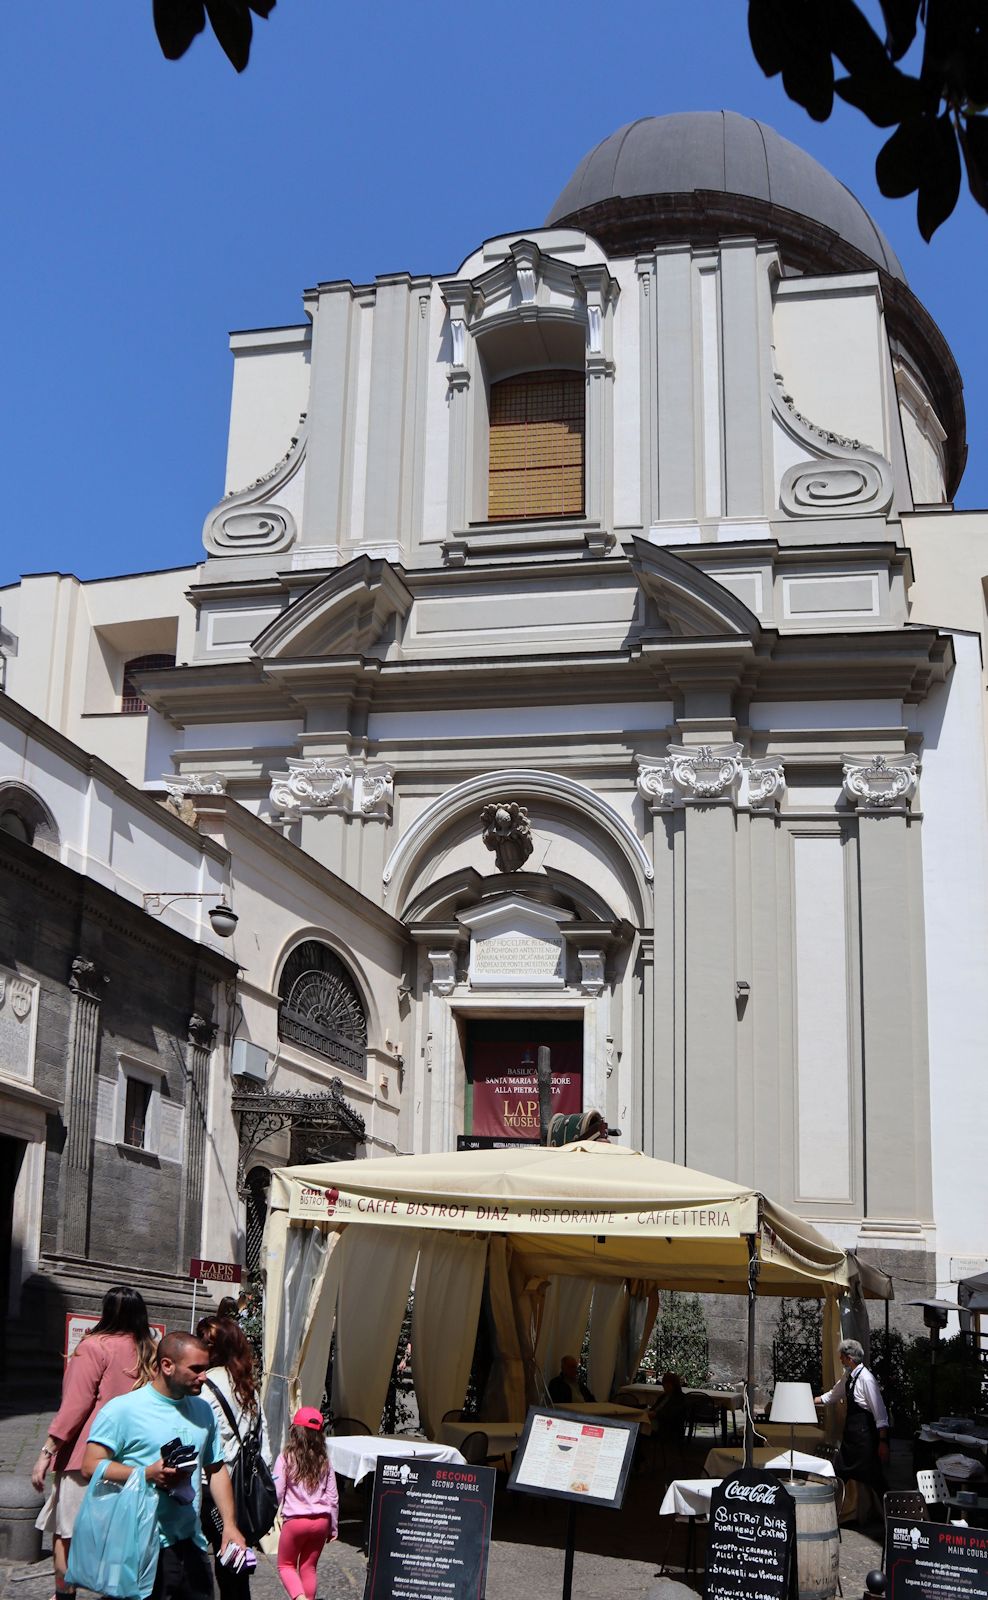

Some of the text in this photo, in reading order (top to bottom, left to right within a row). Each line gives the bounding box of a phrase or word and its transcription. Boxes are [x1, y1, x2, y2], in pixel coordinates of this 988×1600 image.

[504, 1117, 541, 1128] MUSEU
[300, 1196, 326, 1206] BISTROT
[357, 1197, 730, 1226] CAFFÈ BISTROT DIAZ RISTORANTE CAFFETTERIA
[200, 1262, 234, 1275] LAPIS
[200, 1271, 233, 1281] MUSEUM
[436, 1470, 476, 1482] SECONDI
[432, 1480, 480, 1492] SECOND COURSE
[724, 1480, 780, 1504] Coca-Cola
[715, 1506, 760, 1524] BISTROT
[714, 1522, 734, 1532] FUORI
[920, 1536, 930, 1544] DIAZ
[939, 1534, 966, 1546] PRIMI
[948, 1546, 988, 1558] MAIN COURS
